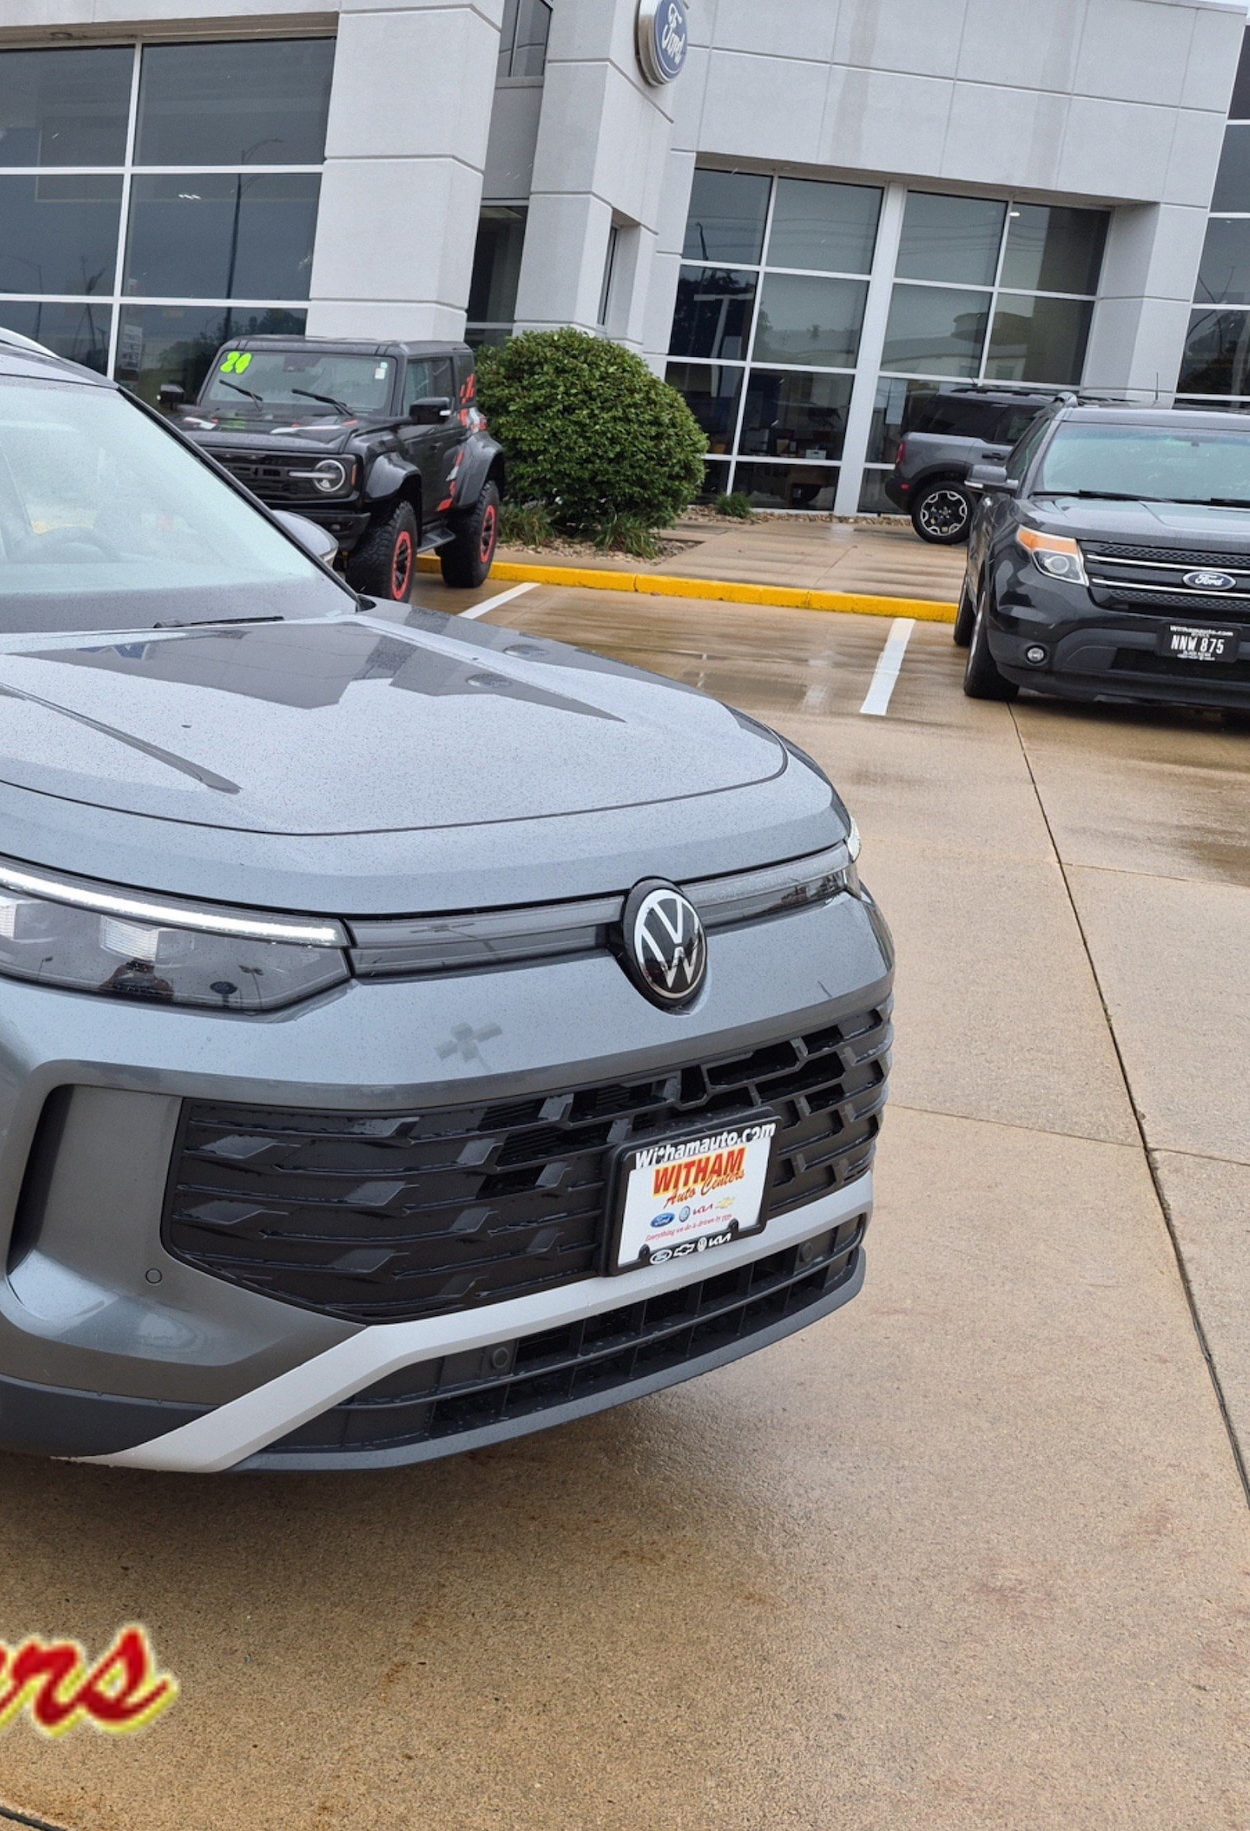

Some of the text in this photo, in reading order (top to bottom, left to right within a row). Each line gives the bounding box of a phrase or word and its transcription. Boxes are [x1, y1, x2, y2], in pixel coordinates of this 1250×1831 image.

[661, 2, 686, 65] Ford
[1193, 573, 1225, 587] Ford
[1200, 637, 1225, 655] 875
[652, 1147, 747, 1196] WITHAM
[663, 1186, 697, 1209] Auto
